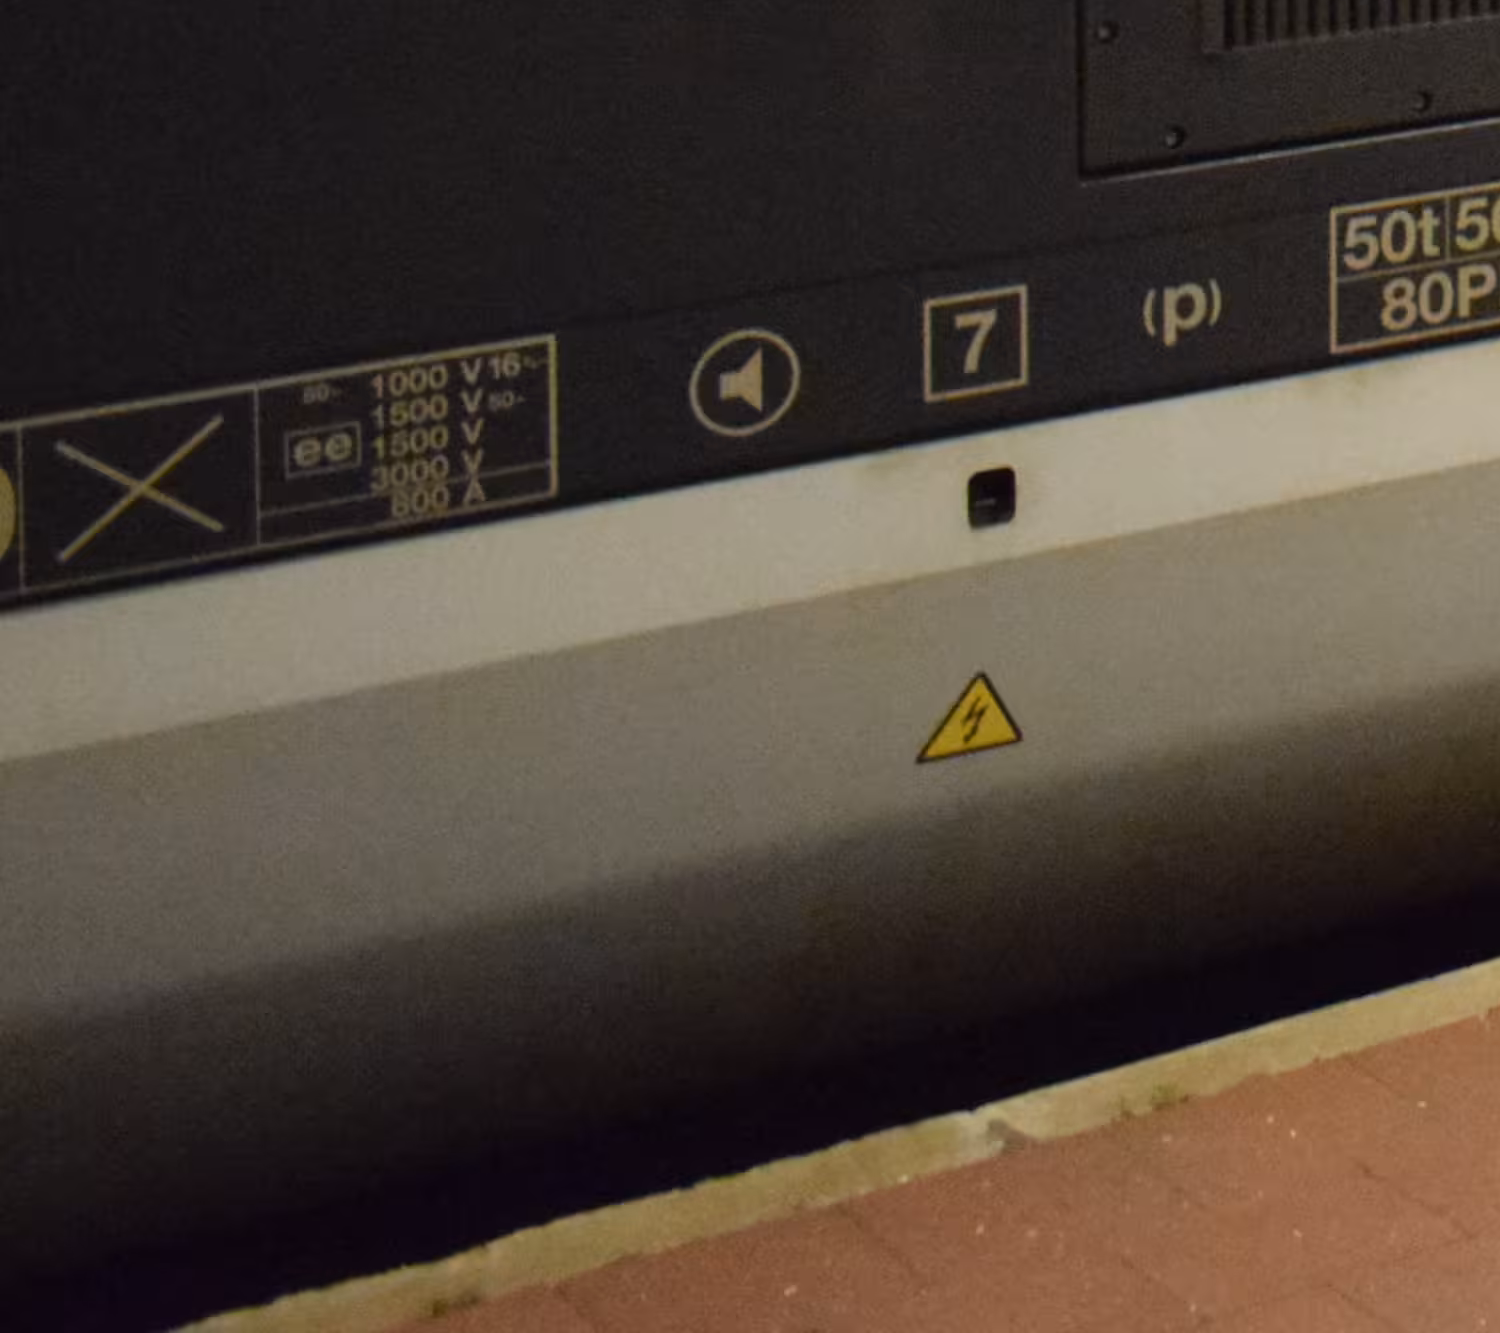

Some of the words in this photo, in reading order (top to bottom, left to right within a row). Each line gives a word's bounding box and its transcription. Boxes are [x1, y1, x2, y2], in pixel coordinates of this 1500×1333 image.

[1343, 206, 1441, 271] 50t
[1142, 277, 1222, 347] (p)
[953, 309, 998, 375] 7
[370, 363, 449, 399] 1000
[460, 357, 483, 385] V
[370, 393, 449, 429] 1500
[460, 388, 483, 414] V
[293, 432, 352, 467] ee
[461, 418, 484, 445] V
[370, 454, 450, 492] 3000
[461, 448, 484, 477] V
